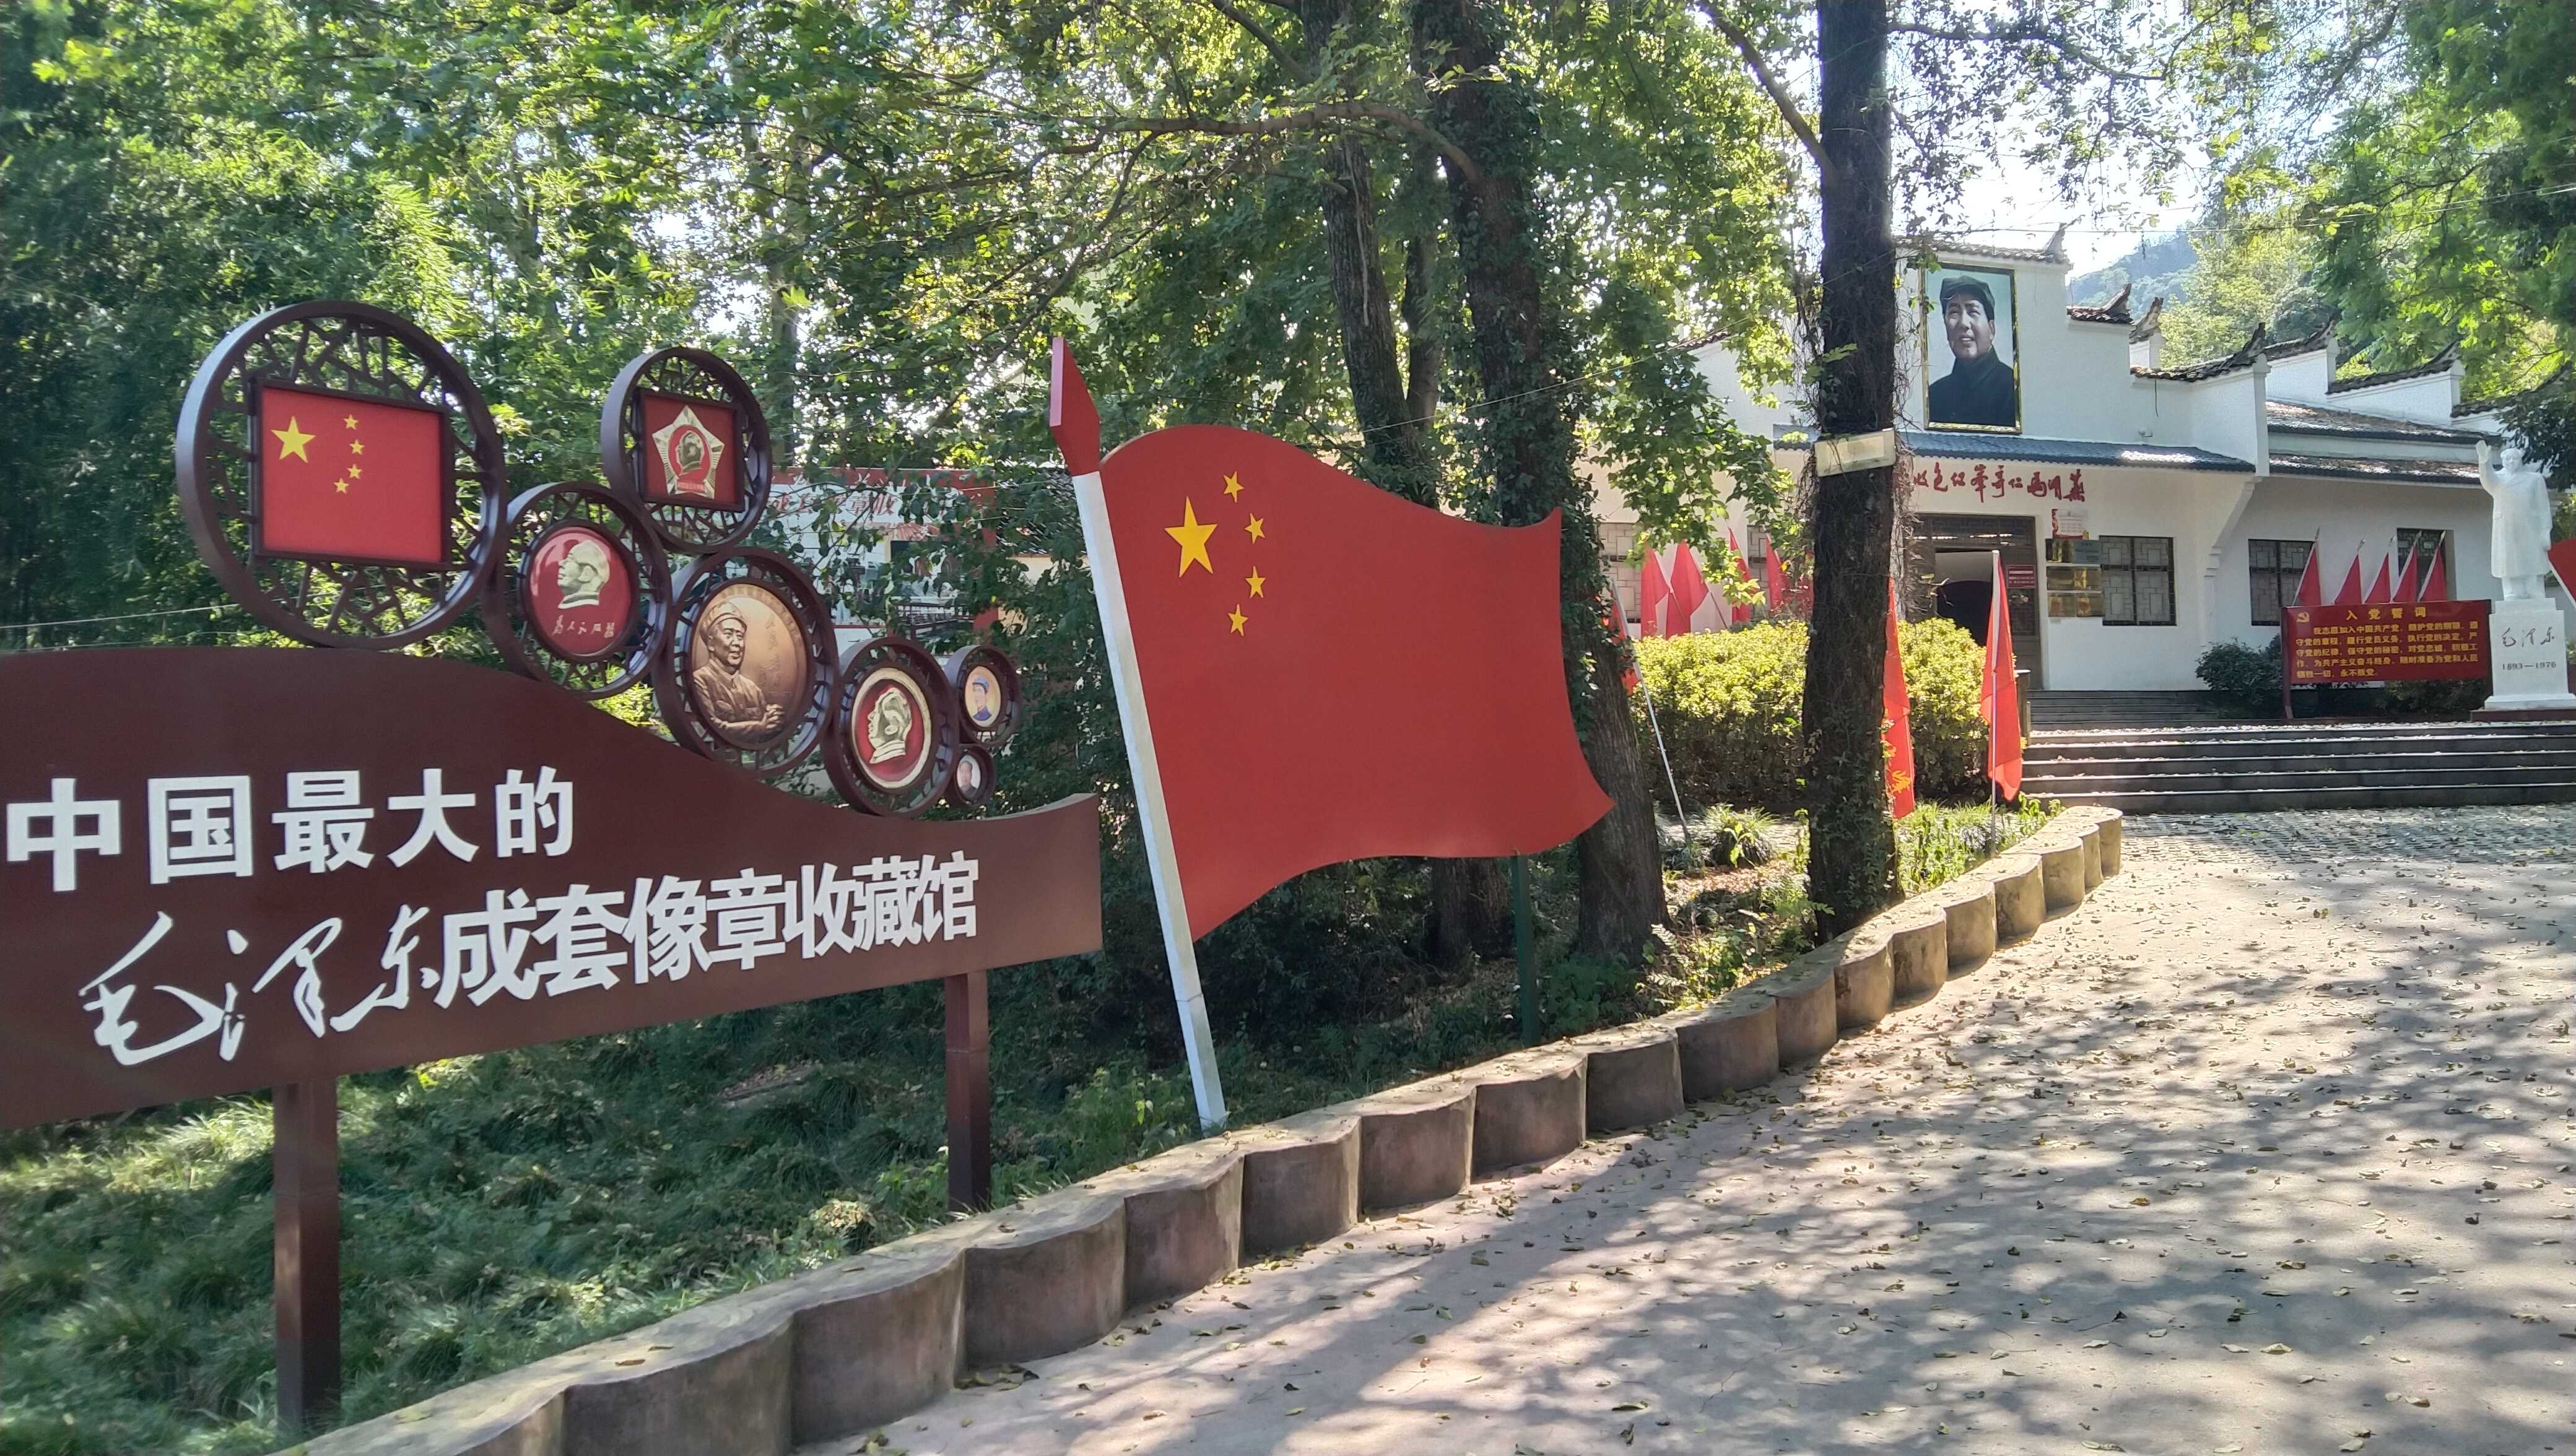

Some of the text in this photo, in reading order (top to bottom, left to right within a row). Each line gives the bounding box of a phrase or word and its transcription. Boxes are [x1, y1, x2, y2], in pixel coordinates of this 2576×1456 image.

[2346, 607, 2426, 621] 入党誓词
[6, 766, 573, 892] 中国最大的
